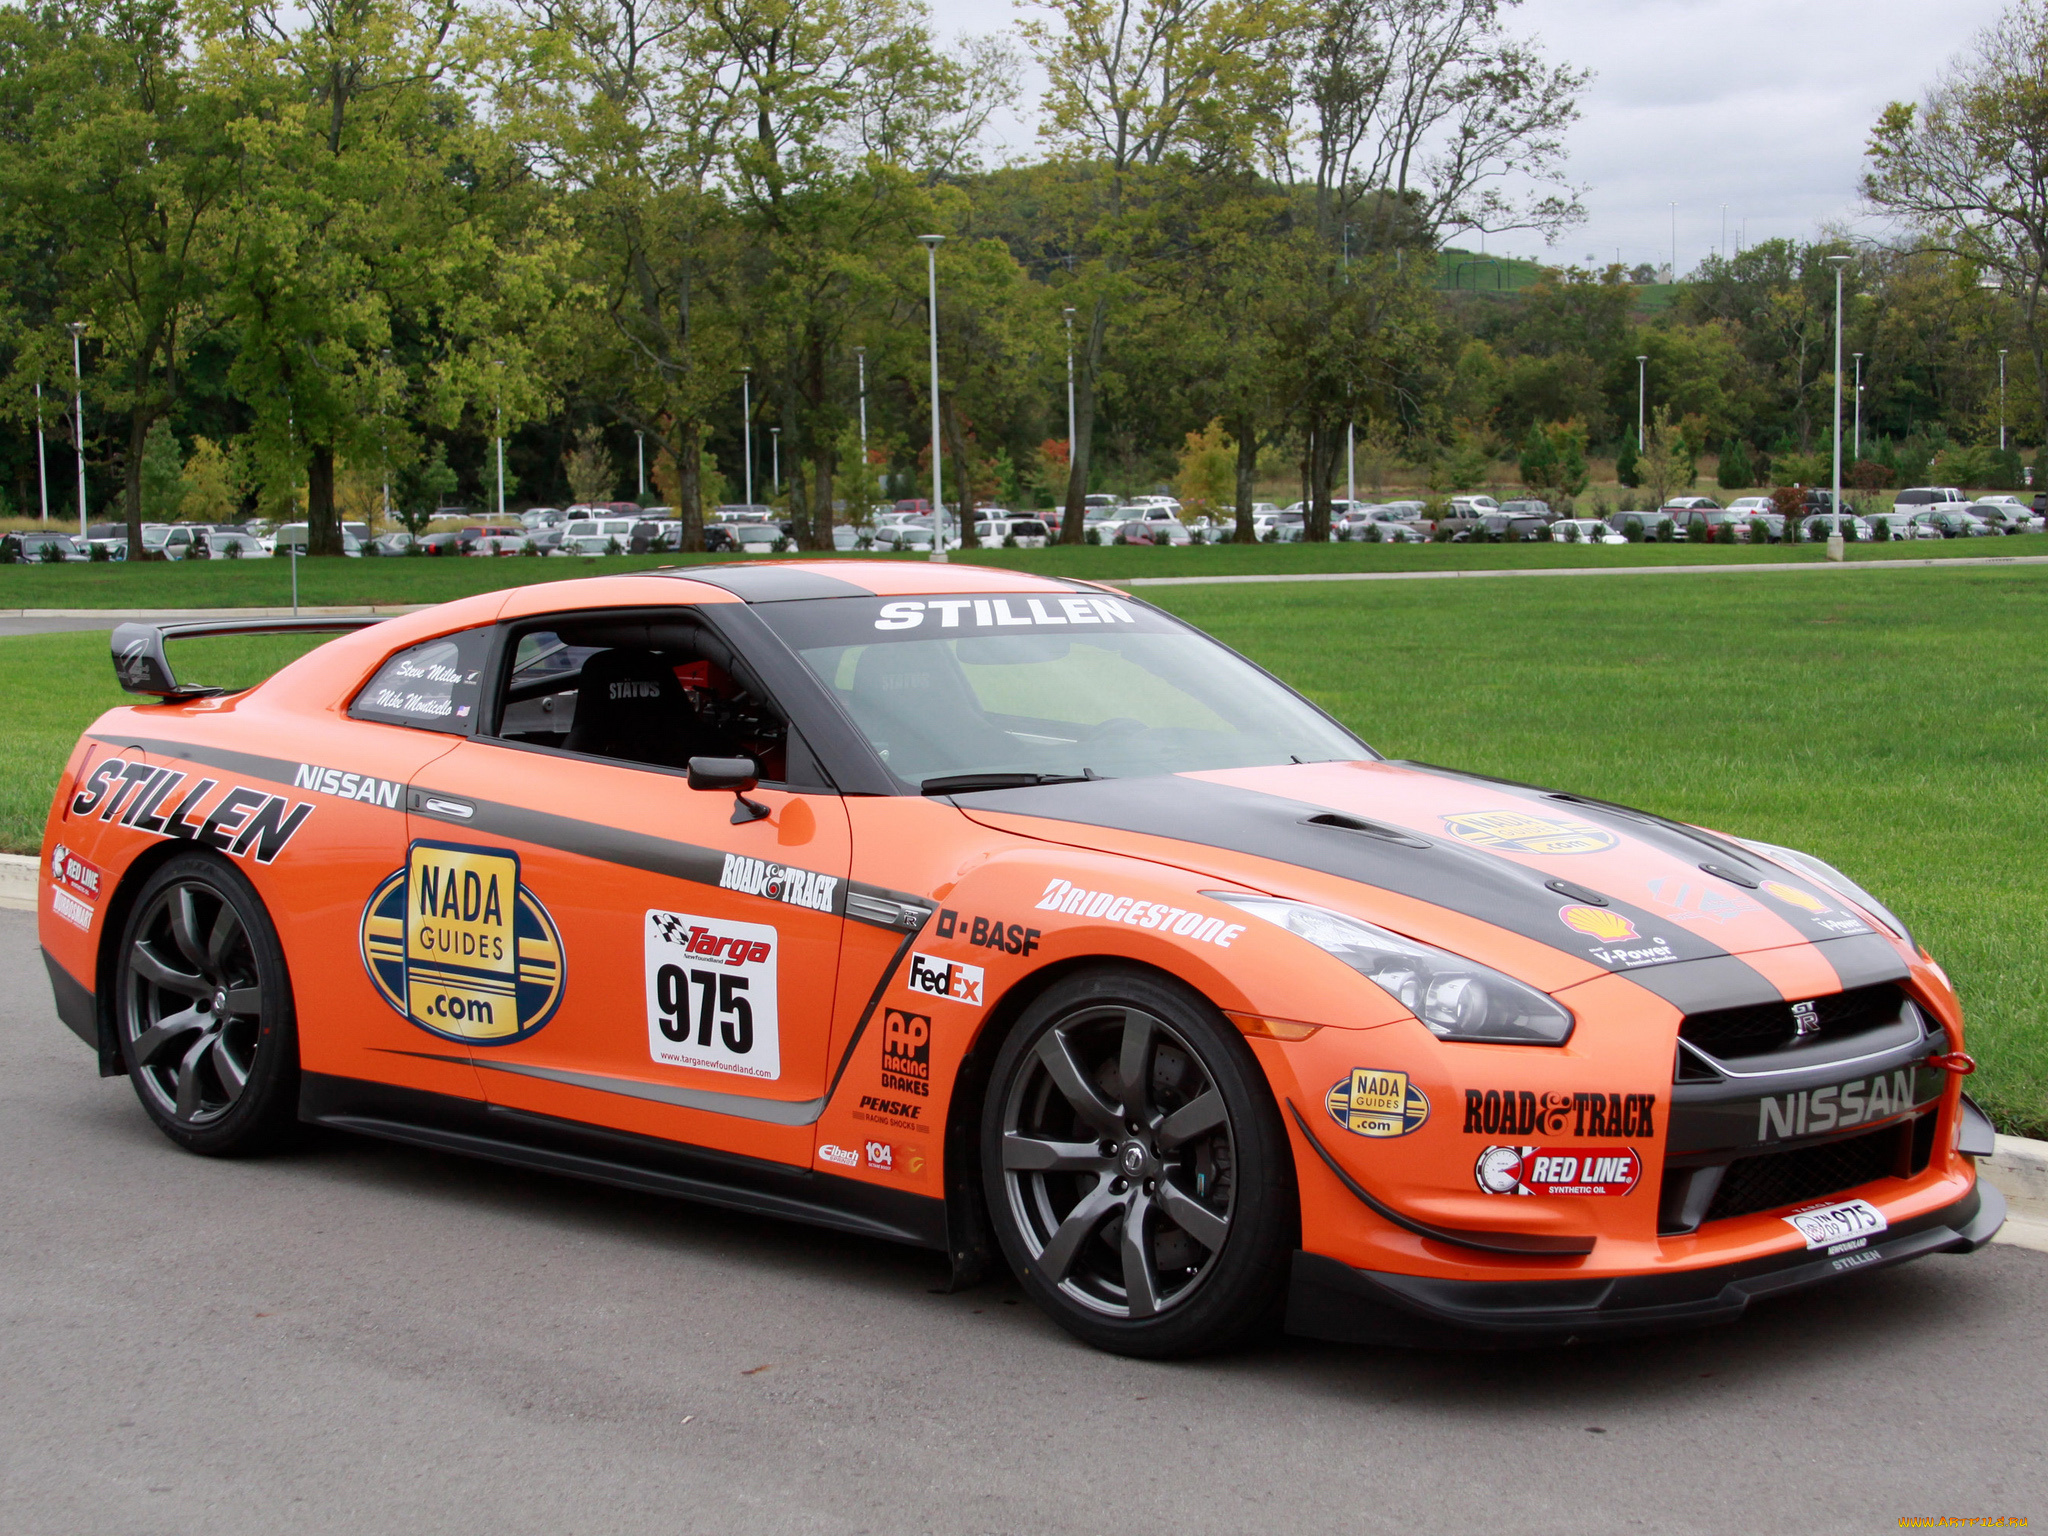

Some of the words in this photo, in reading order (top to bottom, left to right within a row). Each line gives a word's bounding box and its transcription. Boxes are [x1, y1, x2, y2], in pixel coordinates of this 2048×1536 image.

[874, 599, 1136, 630] STILLEN
[396, 660, 425, 679] Steve
[426, 664, 463, 684] Millen
[376, 688, 403, 709] Mike
[404, 692, 453, 716] Monticello
[294, 763, 401, 809] NISSAN
[72, 757, 316, 866] STILLEN
[66, 857, 82, 881] RED
[81, 866, 99, 893] LINE
[420, 864, 503, 927] NADA
[1035, 878, 1246, 949] BRIDGESTONE
[420, 926, 504, 961] GUIDES
[685, 926, 772, 967] Targa
[969, 916, 1042, 957] BASF
[683, 953, 724, 964] Newfoundland
[1593, 945, 1672, 964] V-Power
[910, 955, 980, 1003] FedEx
[427, 991, 494, 1025] .com
[656, 963, 754, 1054] 975
[1791, 1000, 1815, 1014] GT
[884, 1011, 929, 1058] AP
[1794, 1011, 1821, 1035] R
[660, 1051, 772, 1078] www.targanewfoundland.com
[883, 1054, 928, 1076] RACING
[881, 1073, 929, 1097] BRAKES
[1357, 1075, 1400, 1098] NADA
[859, 1095, 922, 1120] PENSKE
[1356, 1096, 1400, 1110] GUIDES
[1758, 1066, 1917, 1141] NISSAN
[865, 1113, 890, 1126] RACING
[889, 1117, 916, 1131] SHOCKS
[1356, 1120, 1391, 1131] .com
[865, 1141, 893, 1166] 104
[1530, 1156, 1579, 1183] RED
[1548, 1185, 1592, 1194] SYNTHETIC
[1592, 1186, 1606, 1194] OIL
[1812, 1213, 1832, 1223] TN
[1824, 1222, 1841, 1236] 09
[1830, 1204, 1878, 1232] 975
[1831, 1249, 1882, 1271] STILLEN
